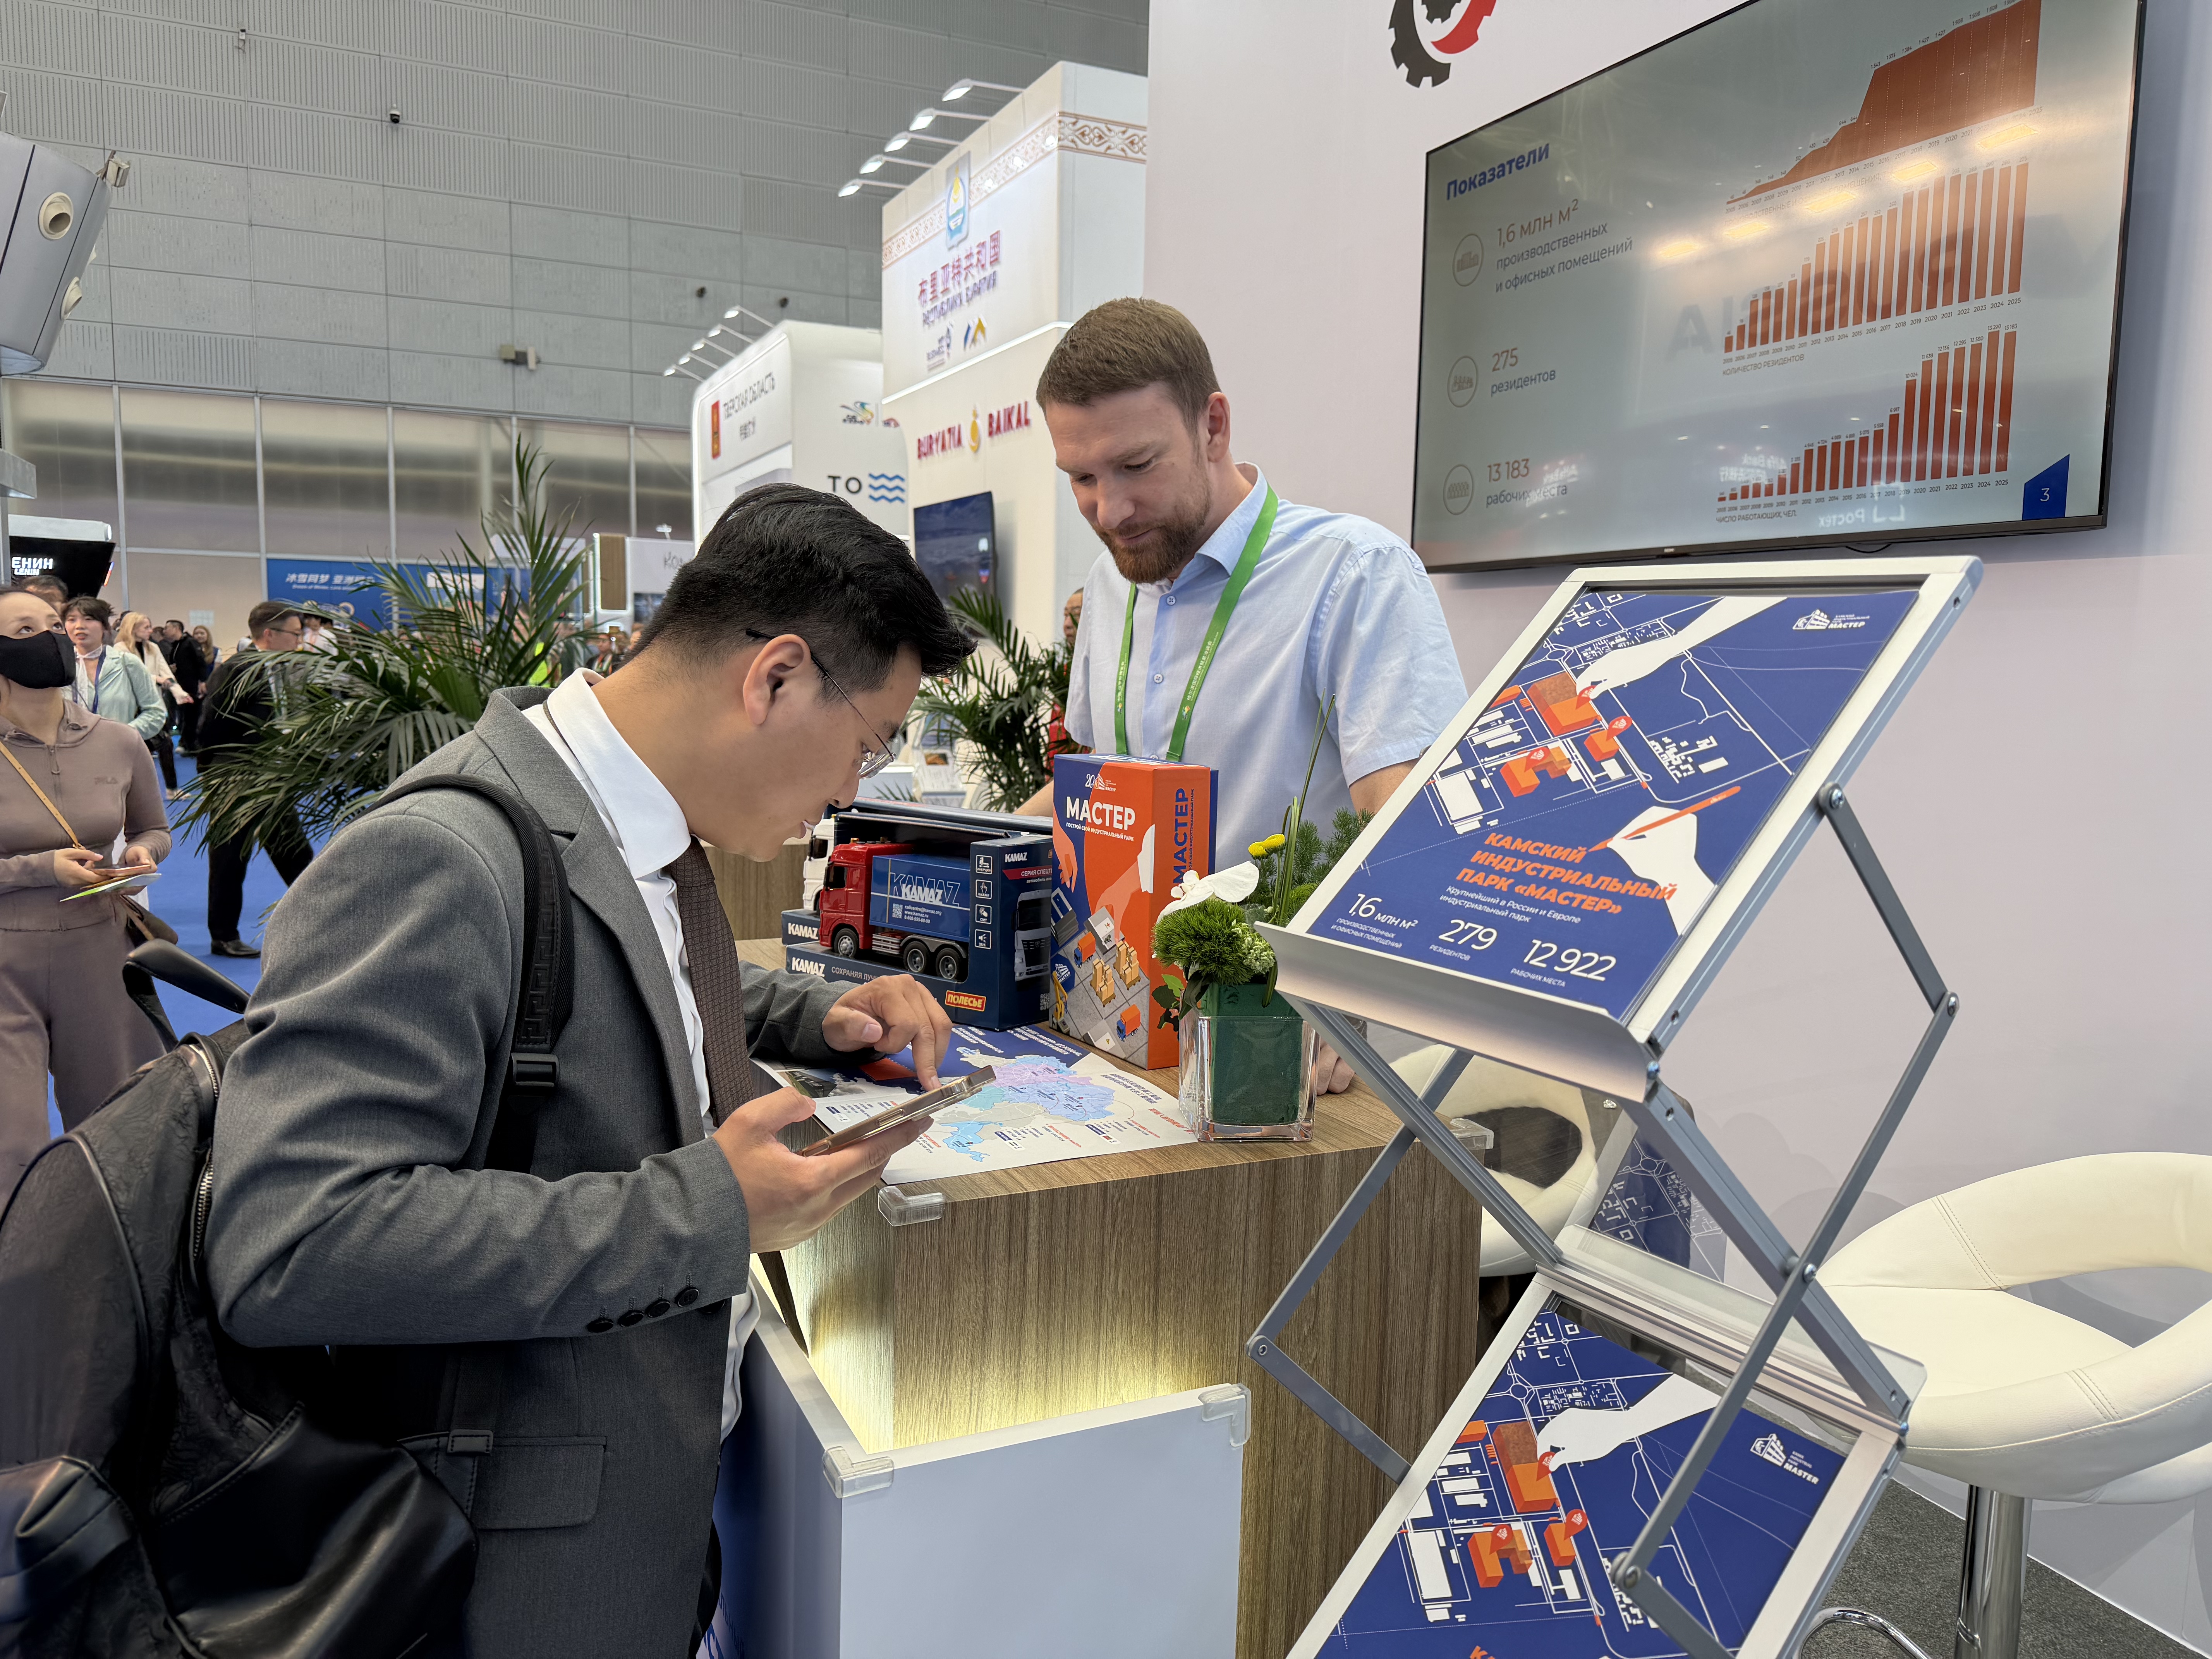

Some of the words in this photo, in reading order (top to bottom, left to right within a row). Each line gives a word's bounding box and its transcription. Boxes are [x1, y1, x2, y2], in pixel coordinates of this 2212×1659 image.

[1928, 140, 1939, 148] 2019
[1944, 134, 1958, 143] 2020
[1446, 143, 1549, 200] Показатели
[1497, 223, 1515, 248] 1,6
[1497, 222, 1607, 272] производственных
[1496, 283, 1503, 293] и
[1505, 265, 1554, 290] офисных
[1558, 237, 1633, 274] помещений
[2008, 297, 2021, 306] 2025
[1492, 347, 1518, 372] 275
[1723, 362, 1763, 376] КОЛИЧЕСТВО
[1764, 354, 1805, 368] РЕЗИДЕНТОВ
[1491, 370, 1556, 397] резидентов
[917, 423, 963, 460] BURYATIA
[988, 401, 1030, 438] BAIKAL
[1487, 462, 1501, 482] 13
[1505, 458, 1530, 479] 183
[1486, 489, 1531, 508] рабочих
[1534, 484, 1567, 500] места
[2040, 488, 2050, 501] 3
[1716, 515, 1736, 523] ЧИСЛО
[14, 568, 40, 576] LENIN
[1085, 773, 1095, 788] 20
[1066, 796, 1135, 831] МАСТЕР
[1066, 822, 1081, 830] ПОСТРОЙ
[1091, 827, 1123, 839] ИНДУСТРИАЛЬНЫЙ
[1173, 788, 1188, 883] МАСТЕР
[1005, 852, 1027, 862] KAMAZ
[1484, 833, 1587, 863] КАМСКИЙ
[1470, 850, 1678, 900] ИНДУСТРИАЛЬНЫЙ
[890, 872, 960, 907] KAMAZ
[902, 884, 943, 904] KAMAZ
[1456, 868, 1514, 891] ПАРК
[1515, 884, 1622, 914] «МАСТЕР»
[905, 905, 942, 916] callcentre@kamaz.org
[1348, 893, 1382, 918] 1,6
[1439, 894, 1509, 919] индустриальный
[1509, 912, 1532, 923] парк
[1446, 885, 1500, 906] Крупнейший
[1507, 900, 1538, 915] России
[1548, 910, 1582, 924] Европе
[788, 922, 818, 940] KAMAZ
[1336, 918, 1396, 939] ПРОИЗВОДСТВЕННЫХ
[1437, 919, 1498, 951] 279
[1364, 933, 1403, 949] ПОМЕЩЕНИЙ
[1429, 944, 1471, 961] РЕЗИДЕНТОВ
[792, 957, 826, 977] KAMAZ
[831, 966, 862, 978] СОХРАНЯЯ
[1523, 939, 1558, 968] 12
[1553, 948, 1617, 982] 922
[1510, 967, 1542, 983] РАБОЧИХ
[1542, 976, 1566, 988] МЕСТА
[947, 993, 982, 1008] ПОЛЕСЬЕ
[1783, 1463, 1820, 1485] MASTER
